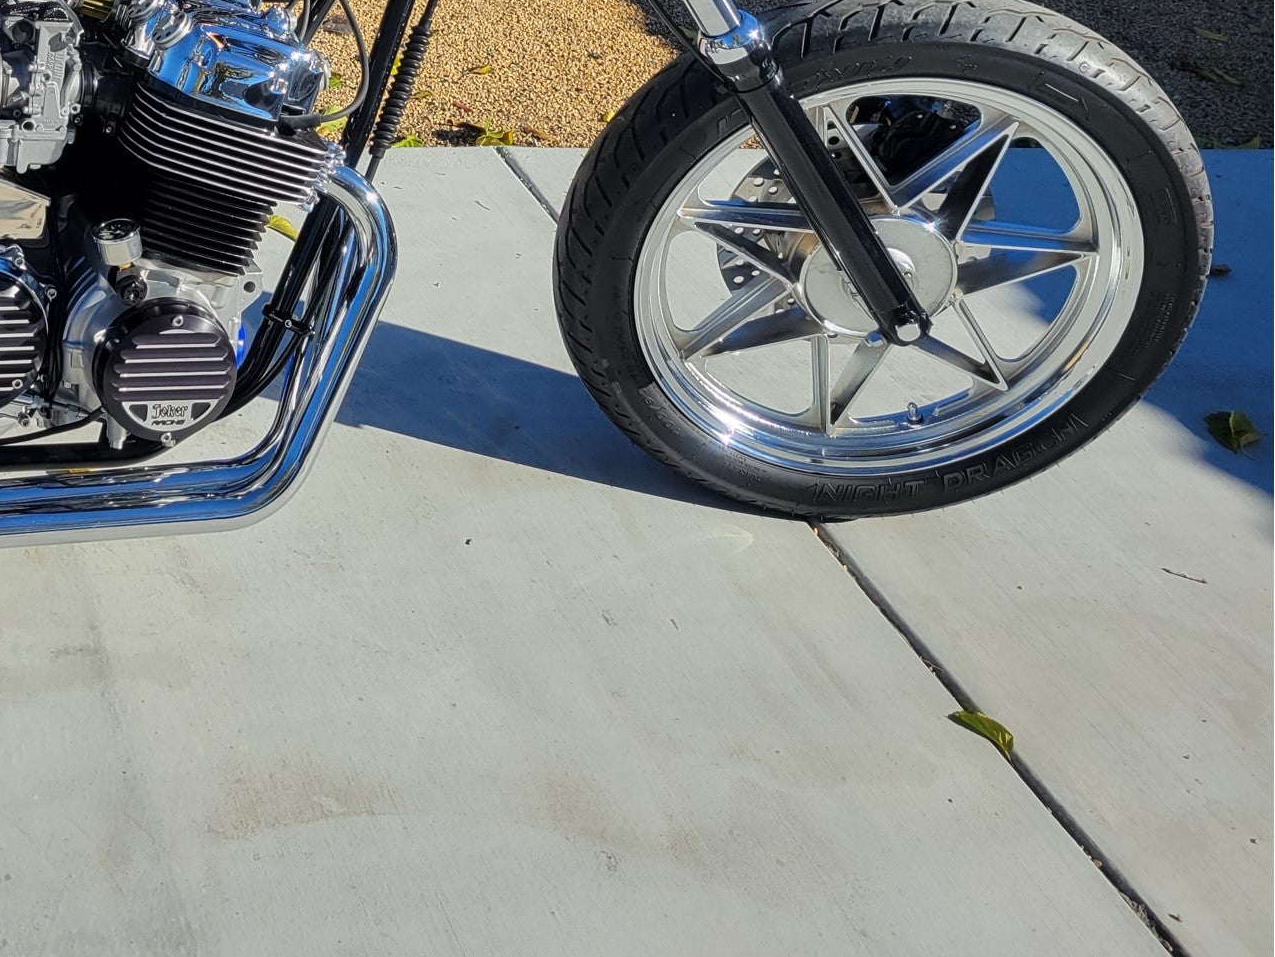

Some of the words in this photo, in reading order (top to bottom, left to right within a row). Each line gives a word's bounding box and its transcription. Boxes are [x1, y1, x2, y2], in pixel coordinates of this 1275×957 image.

[151, 403, 188, 419] Joker
[811, 479, 926, 503] NIGHT
[942, 413, 1089, 492] DRAGON
